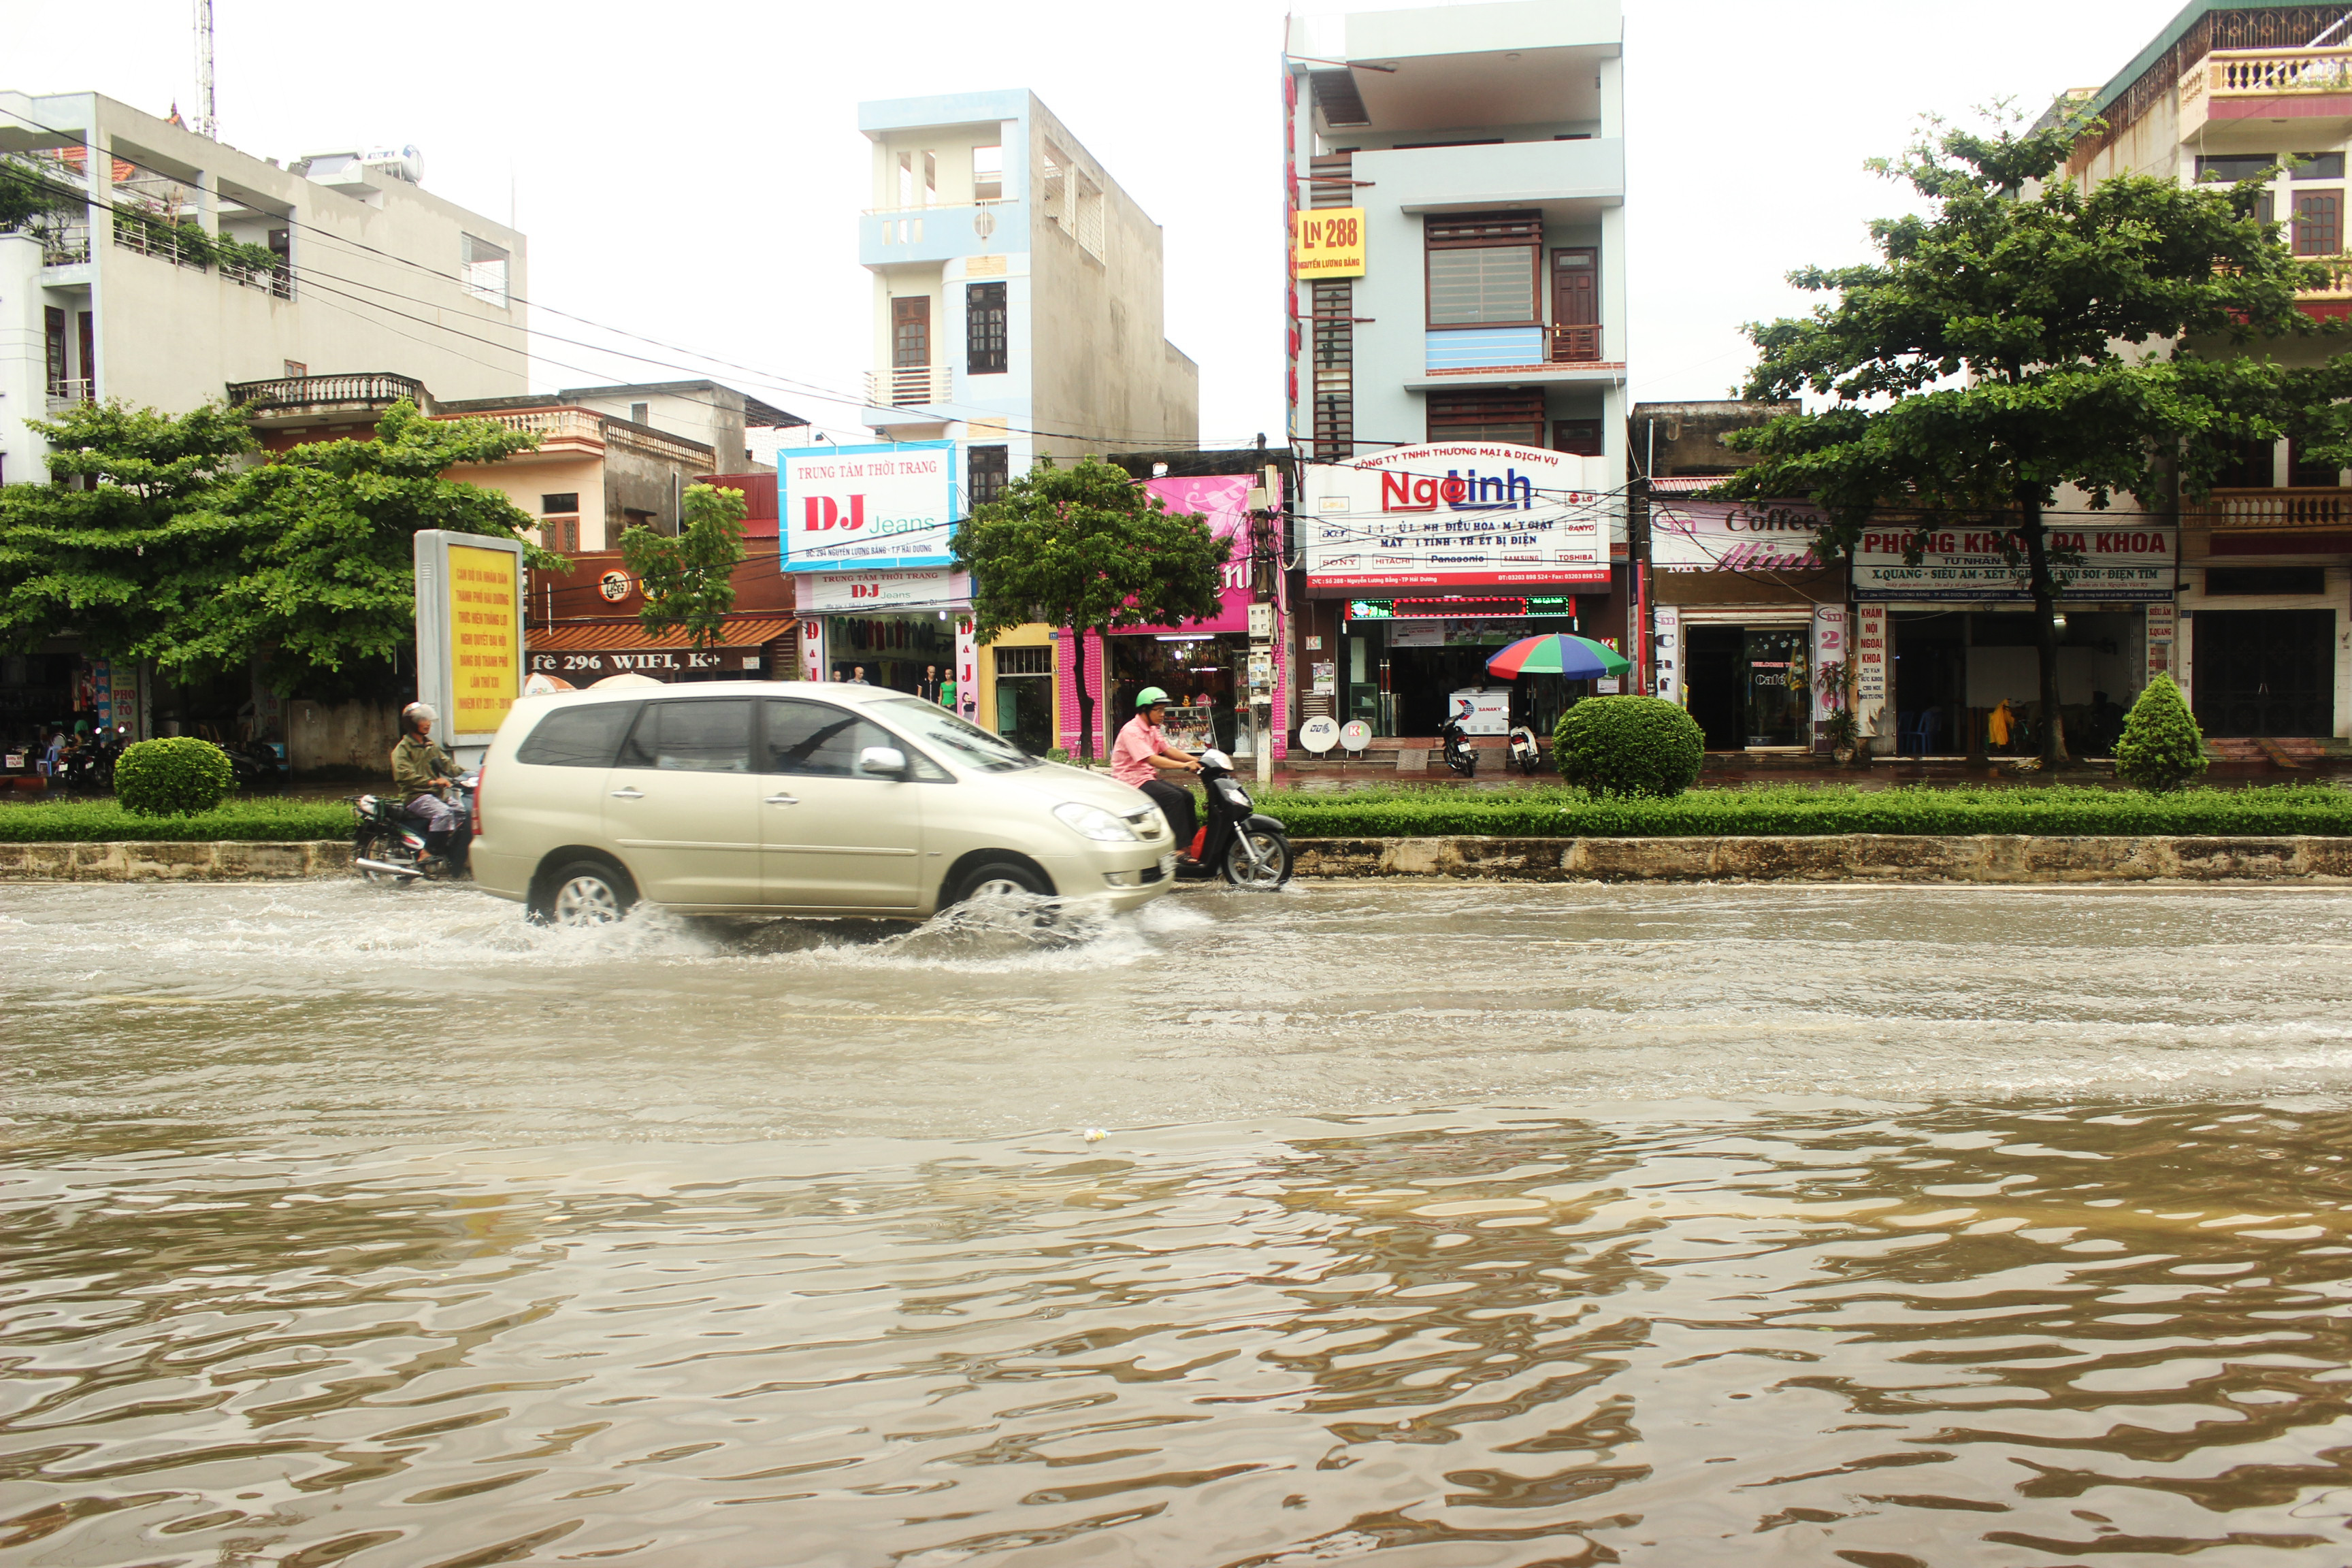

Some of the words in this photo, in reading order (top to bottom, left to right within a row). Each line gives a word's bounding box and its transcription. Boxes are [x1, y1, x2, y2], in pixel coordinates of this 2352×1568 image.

[1303, 220, 1321, 249] LN
[1326, 218, 1358, 248] 288
[1354, 458, 1382, 471] CÔNG
[1385, 454, 1398, 463] TY
[1403, 450, 1430, 460] TNHH
[1433, 446, 1476, 457] THƯƠNG
[1480, 448, 1501, 458] MẠI
[1505, 450, 1512, 458] &
[1515, 451, 1541, 461] DỊCH
[1544, 457, 1558, 467] VỤ
[798, 466, 835, 479] TRUNG
[839, 462, 863, 477] TÂM
[867, 459, 894, 476] THỜI
[898, 460, 937, 474] TRANG
[802, 494, 867, 532] DJ
[869, 515, 935, 534] Jeans
[1726, 509, 1818, 532] Coffee
[1322, 529, 1348, 538] acer
[1496, 536, 1505, 546] BỊ
[1511, 533, 1536, 546] ĐIỆN
[2096, 533, 2166, 553] KHOA
[816, 549, 826, 557] 294
[1431, 555, 1484, 564] Panasonic
[1872, 570, 1923, 581] X.QUANG
[2082, 570, 2100, 578] SOI
[2138, 570, 2158, 578] TIM
[851, 584, 880, 598] DJ
[1861, 606, 1882, 618] KHÁM
[806, 621, 819, 639] D
[1865, 621, 1878, 635] NỘI
[963, 644, 970, 653] &
[532, 654, 557, 670] fê
[564, 655, 602, 670] 296
[610, 653, 680, 671] WIFI,
[688, 653, 720, 669] K+
[1862, 653, 1881, 663] KHOA
[962, 664, 972, 682] J
[113, 689, 135, 700] PHO
[117, 705, 132, 715] TO
